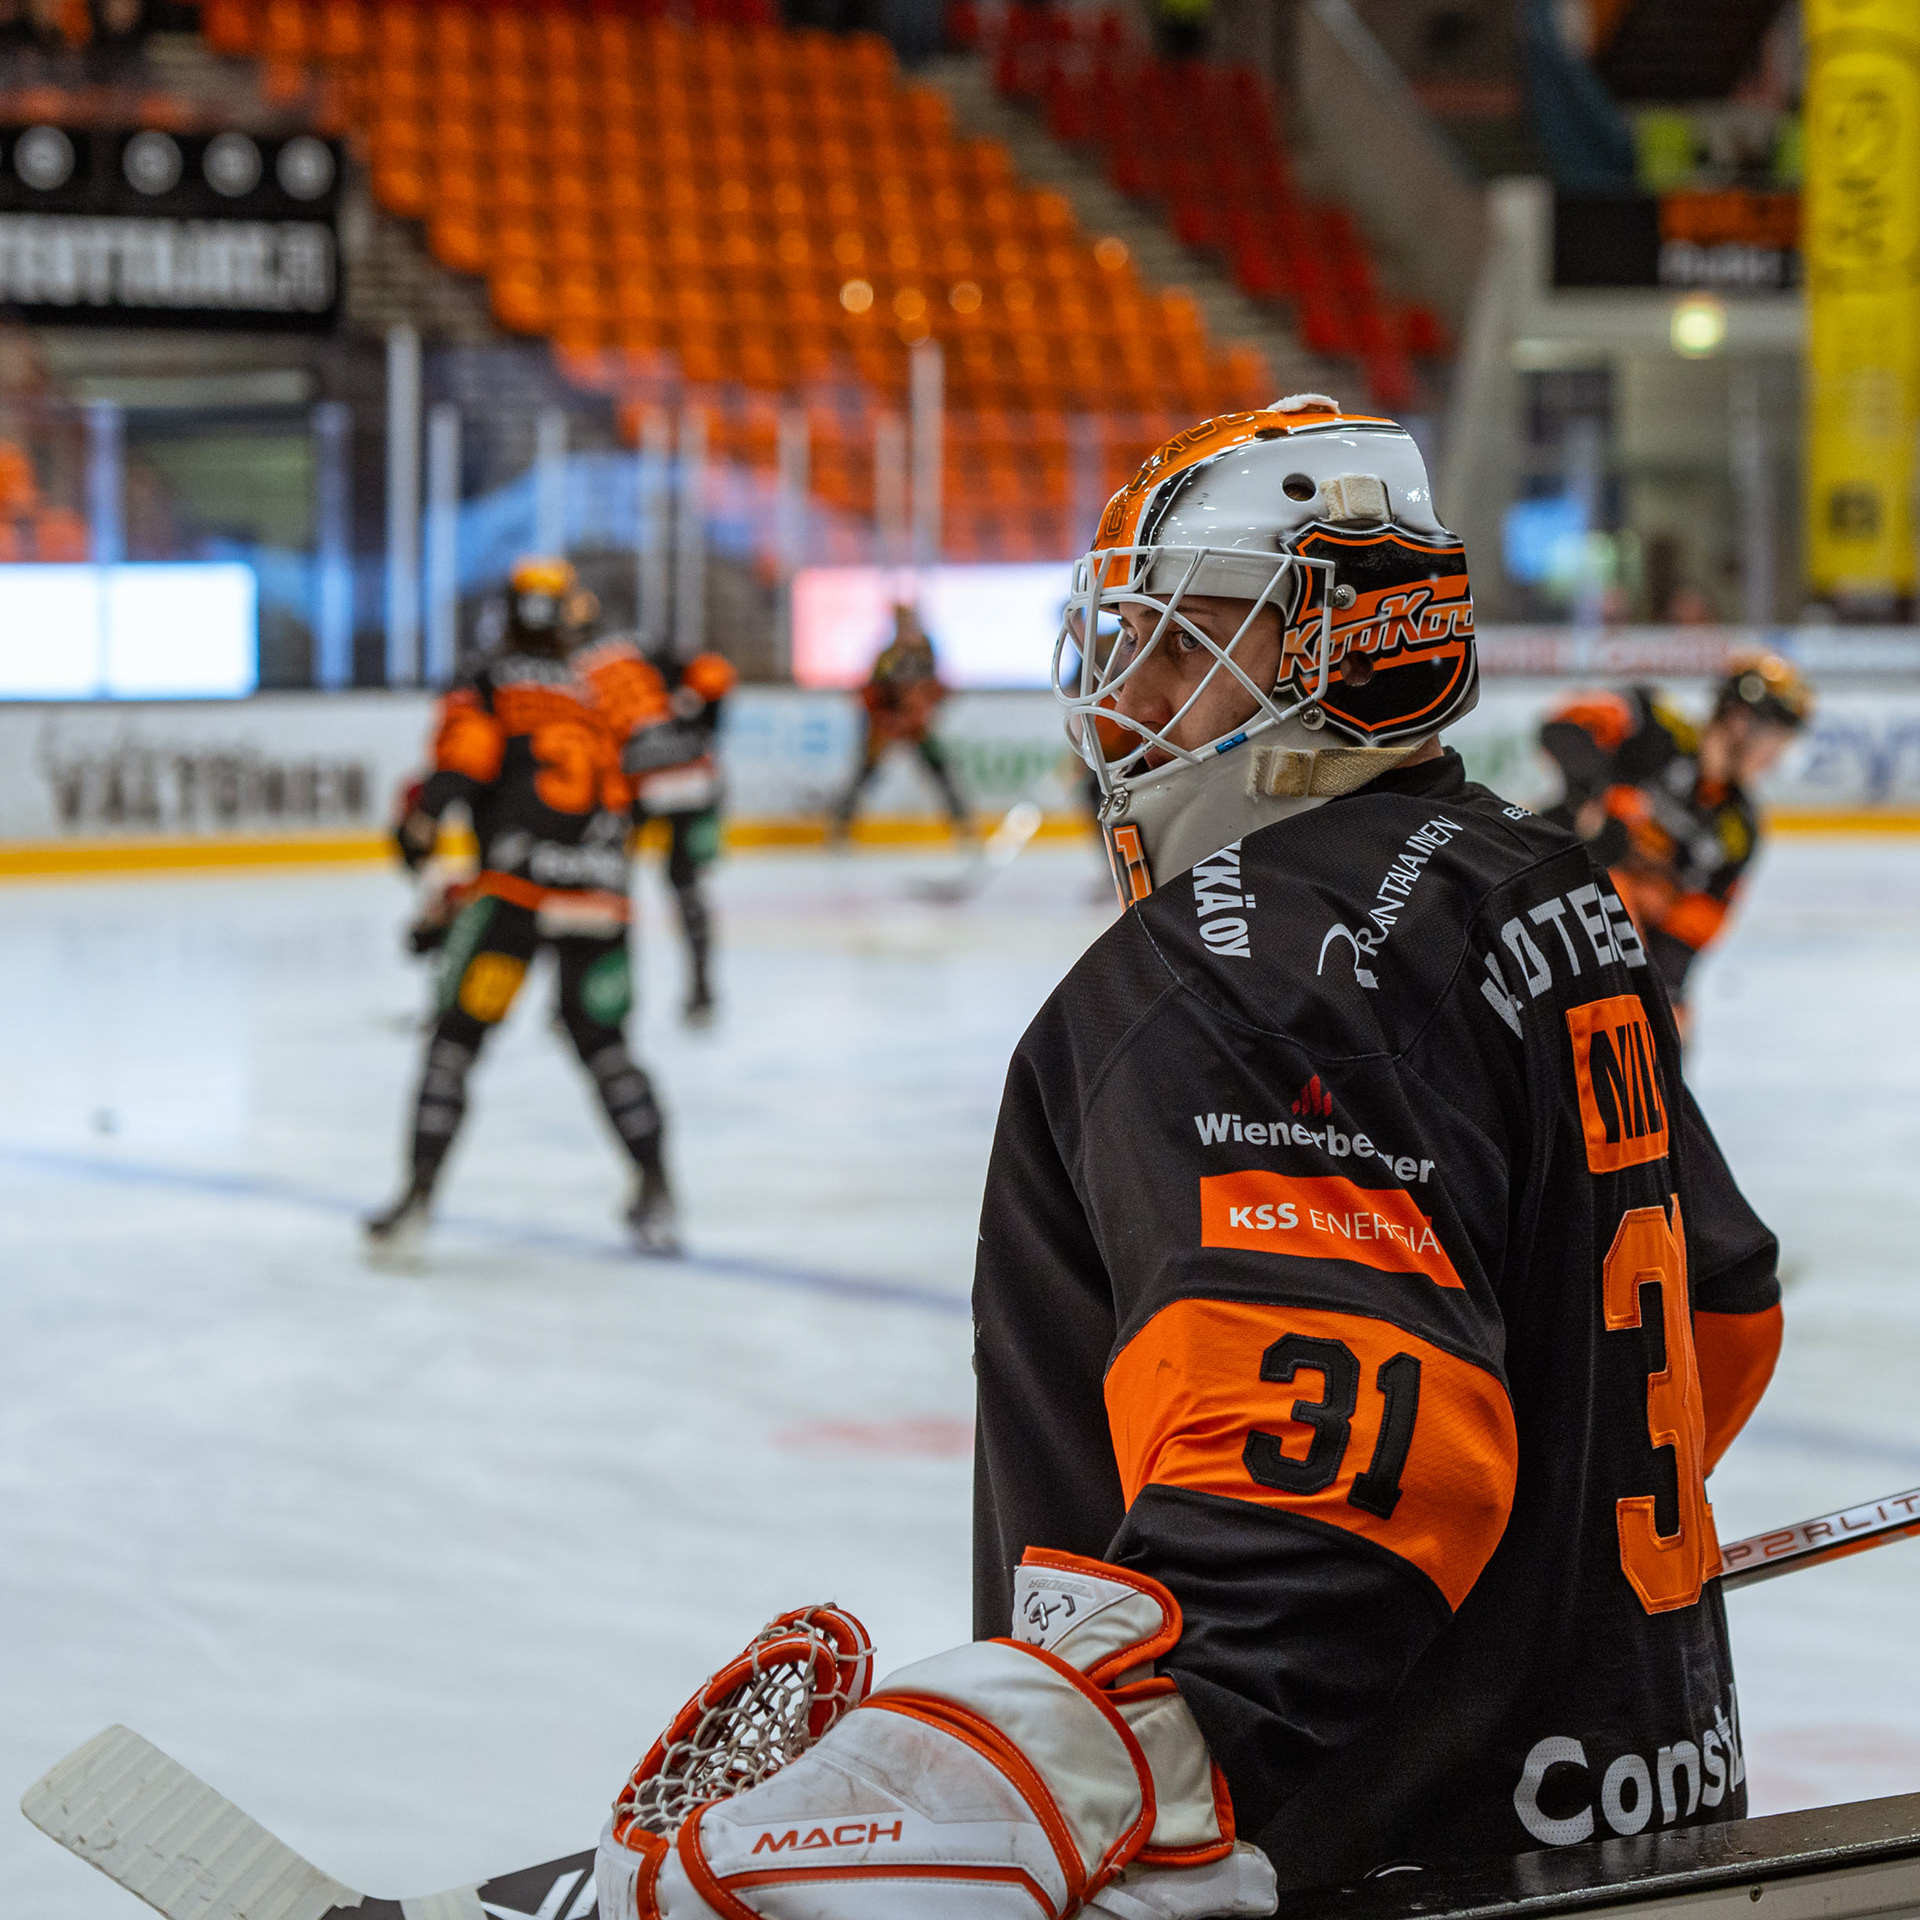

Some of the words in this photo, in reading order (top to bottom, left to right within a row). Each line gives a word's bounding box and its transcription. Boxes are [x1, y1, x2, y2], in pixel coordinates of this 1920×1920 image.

[1229, 1203, 1299, 1229] KSS
[1241, 1332, 1421, 1520] 31
[750, 1820, 903, 1855] MACH
